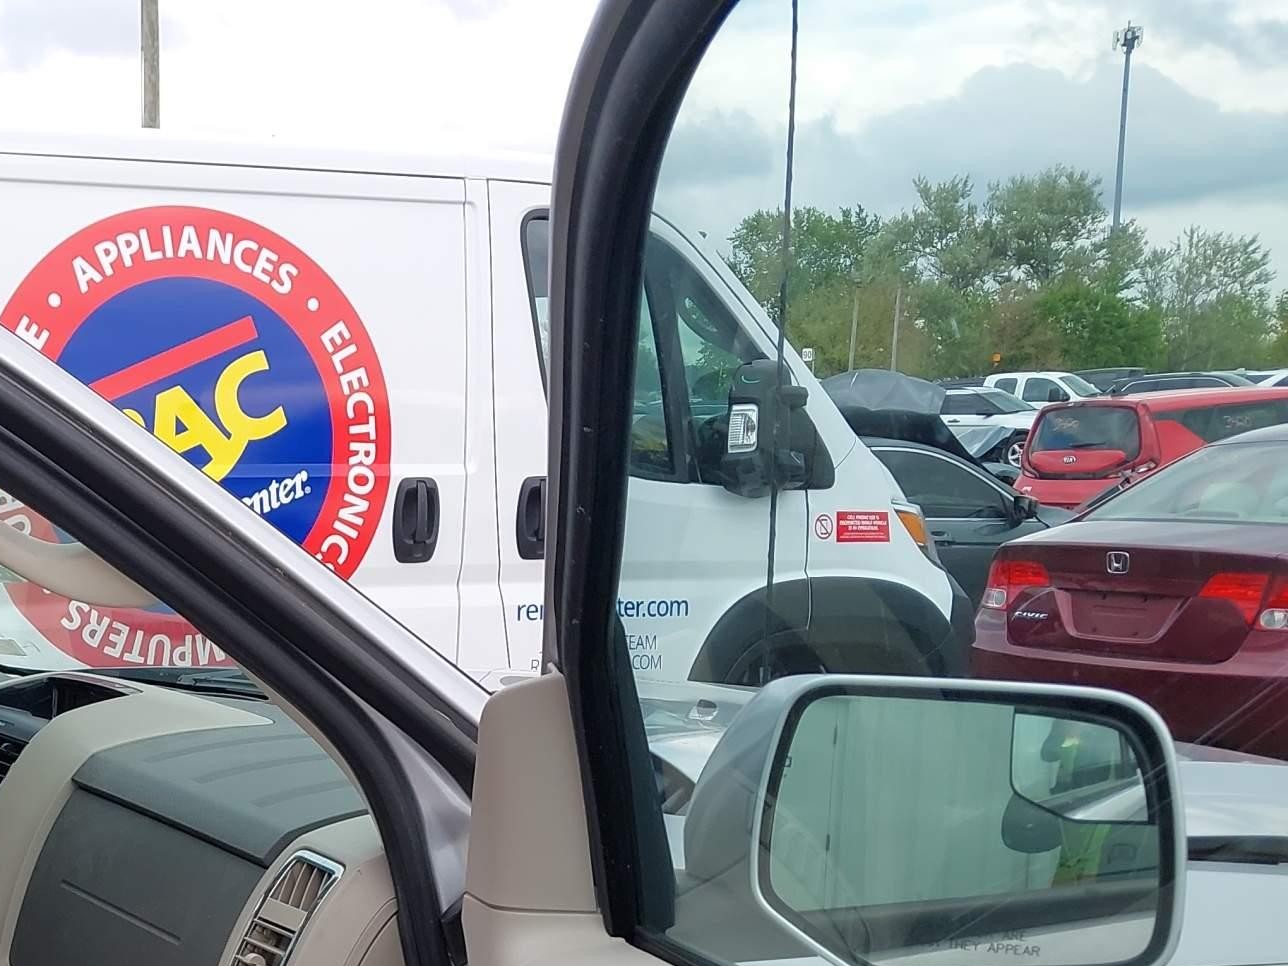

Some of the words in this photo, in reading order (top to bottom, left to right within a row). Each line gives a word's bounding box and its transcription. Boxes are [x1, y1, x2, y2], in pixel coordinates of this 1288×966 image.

[71, 225, 300, 296] APPLIANCES
[122, 349, 288, 483] AC
[319, 319, 378, 570] ELECTRONIC
[60, 599, 227, 667] MPUTERS
[1014, 610, 1049, 620] CIVIC
[986, 943, 1041, 957] APPEAR
